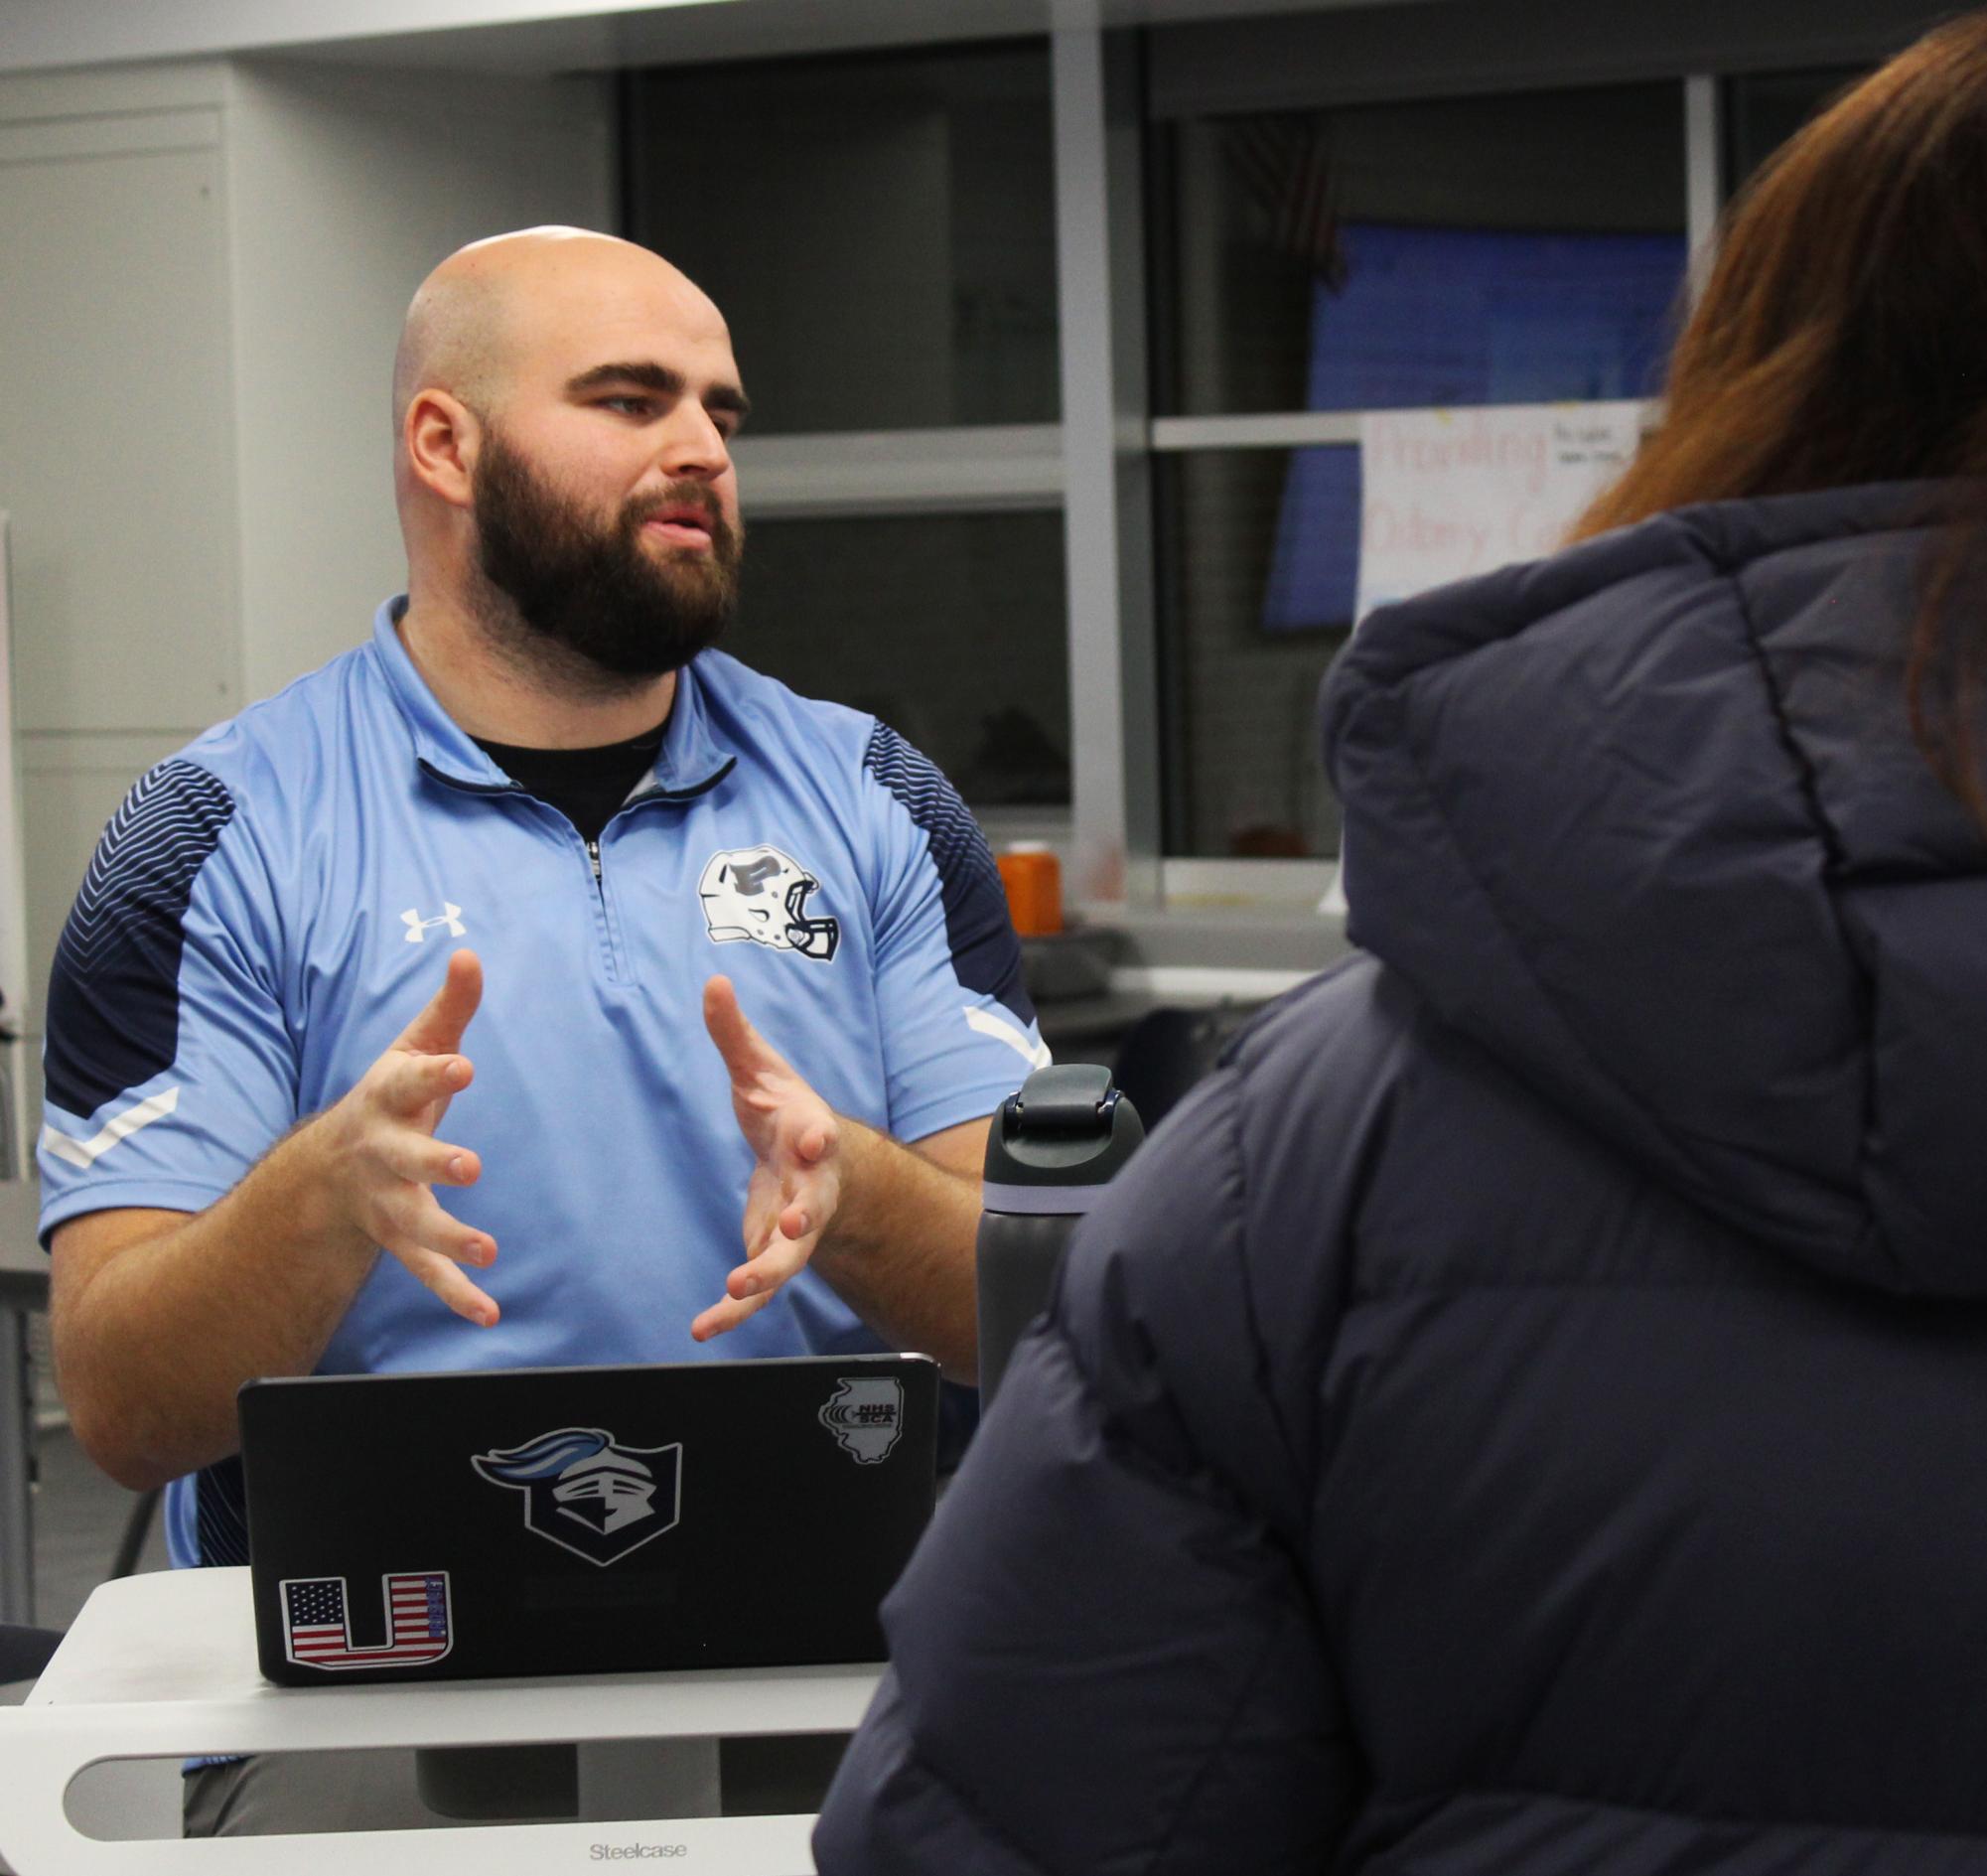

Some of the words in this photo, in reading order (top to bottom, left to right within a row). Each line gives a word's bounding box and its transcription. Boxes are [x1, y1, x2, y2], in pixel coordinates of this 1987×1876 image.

[859, 1403, 895, 1413] NHS
[859, 1414, 894, 1423] SCA
[589, 1842, 687, 1860] Steelcase
